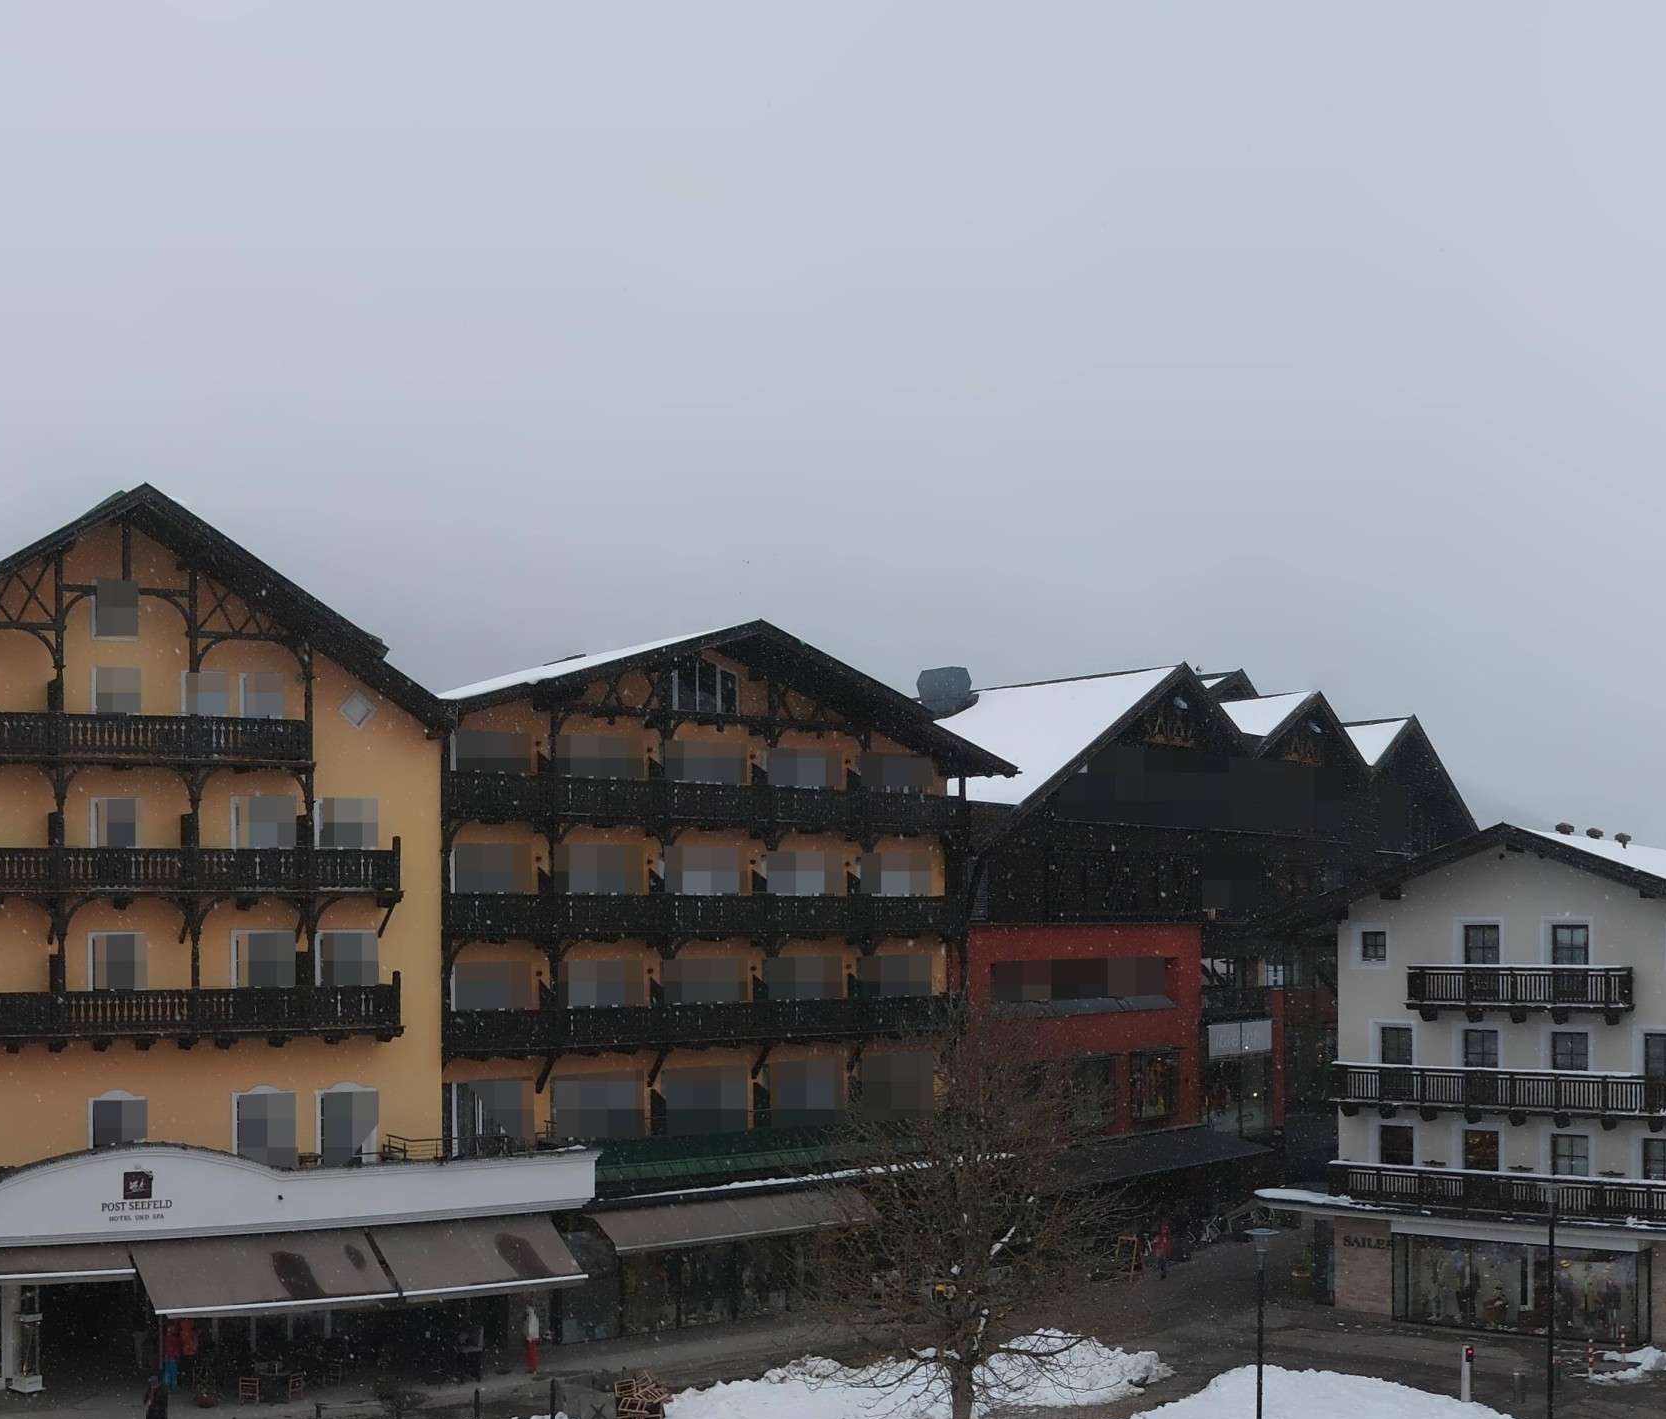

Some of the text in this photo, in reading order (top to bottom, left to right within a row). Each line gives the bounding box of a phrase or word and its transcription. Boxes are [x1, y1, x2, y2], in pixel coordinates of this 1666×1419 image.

[101, 1199, 173, 1212] POST SEEFELD
[109, 1214, 132, 1222] HOTEL
[135, 1213, 150, 1221] UND
